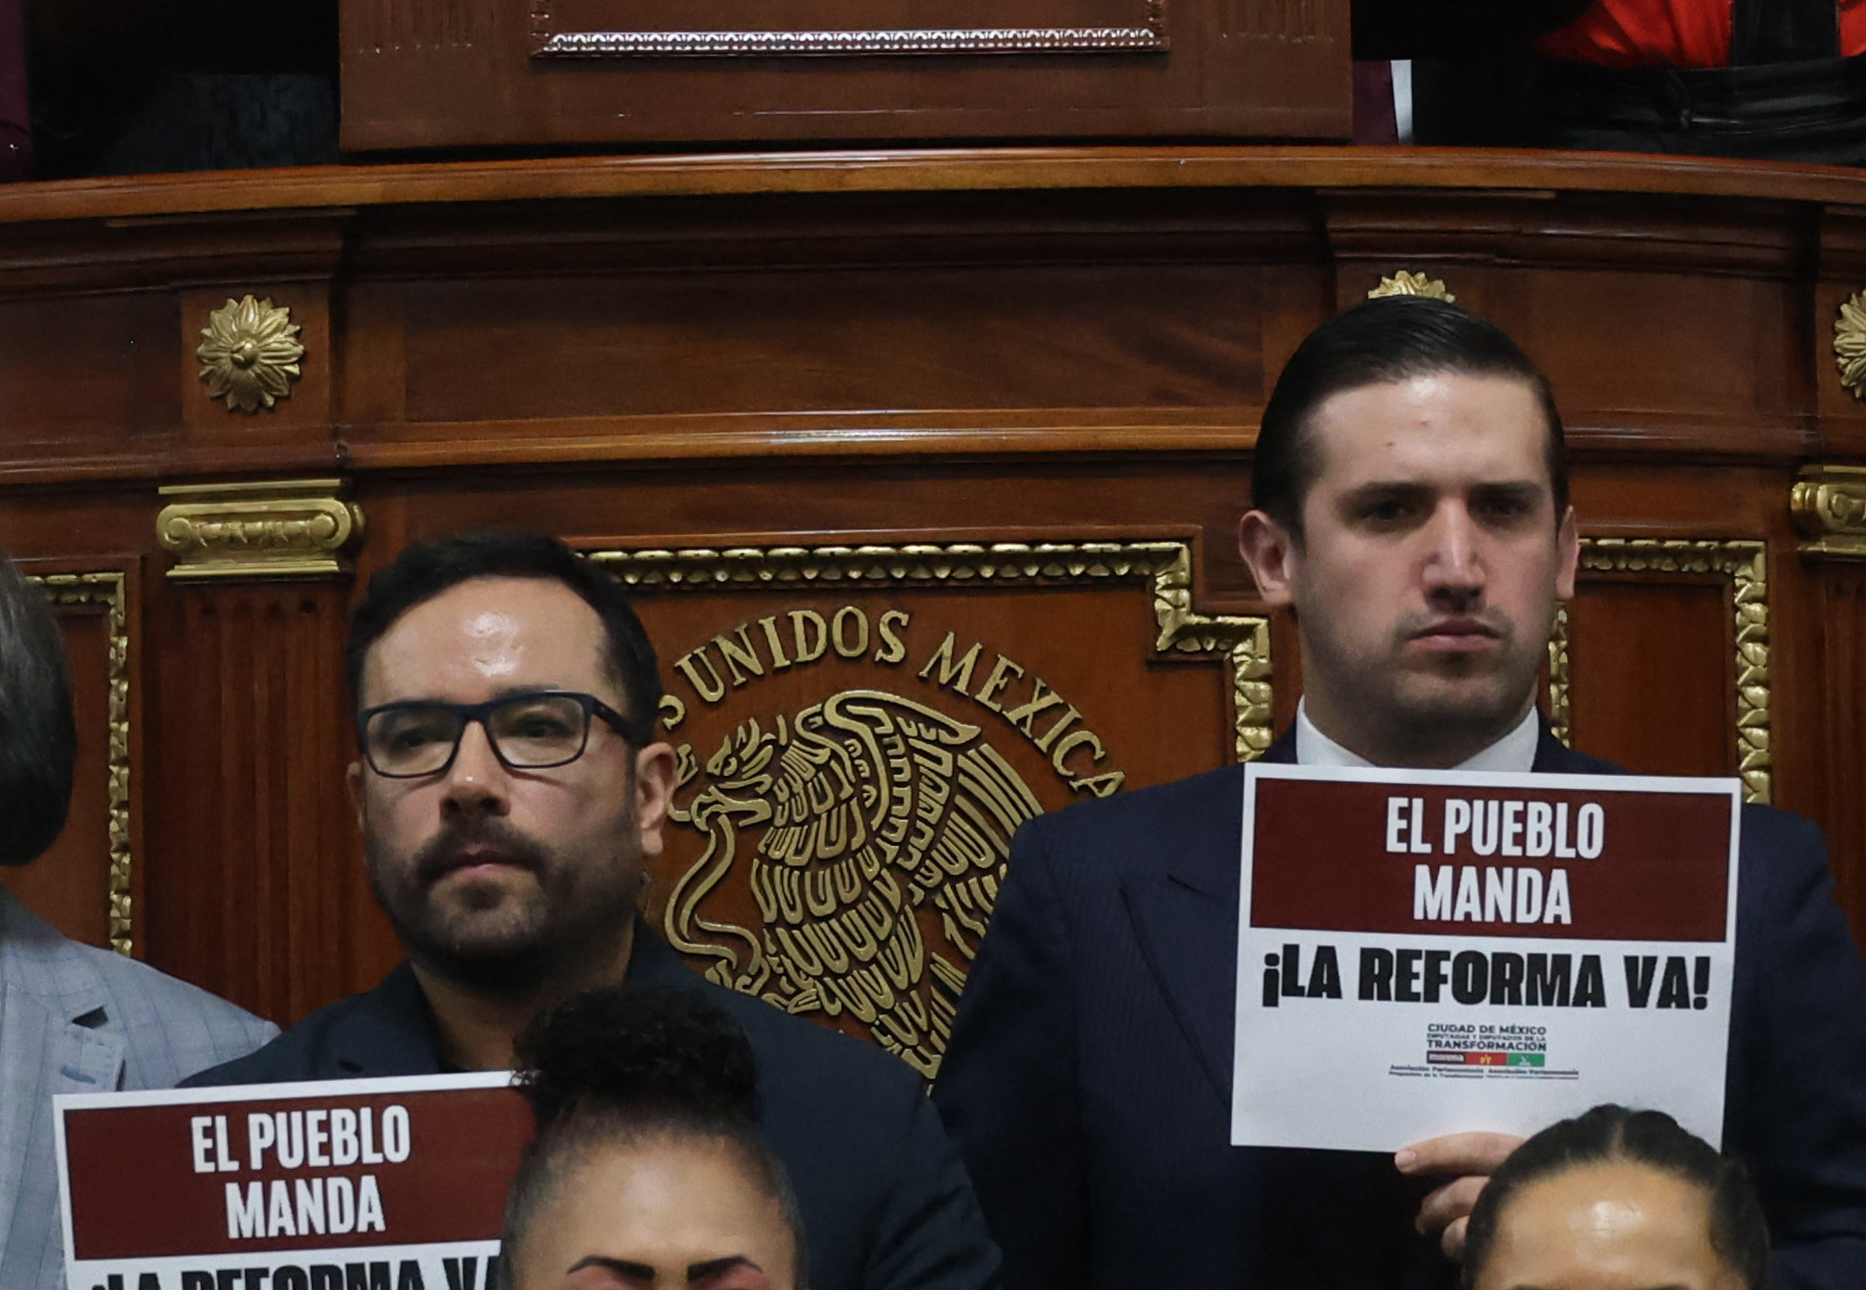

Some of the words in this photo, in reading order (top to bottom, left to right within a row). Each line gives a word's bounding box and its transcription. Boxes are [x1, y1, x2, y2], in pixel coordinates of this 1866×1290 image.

[674, 606, 909, 702] UNIDOS
[1387, 797, 1431, 853] EL
[1444, 799, 1604, 858] PUEBLO
[1414, 865, 1571, 924] MANDA
[1263, 944, 1342, 1007] ¡LA
[1359, 948, 1606, 1007] REFORMA
[1624, 956, 1710, 1010] VA!
[1427, 1040, 1546, 1051] TRANSFORMACIÓN
[1428, 1024, 1476, 1033] CIUDAD
[1479, 1025, 1495, 1033] DE
[1499, 1024, 1546, 1035] MÉXICO
[192, 1116, 239, 1172] EL
[248, 1105, 410, 1169] PUEBLO
[226, 1176, 385, 1238] MANDA
